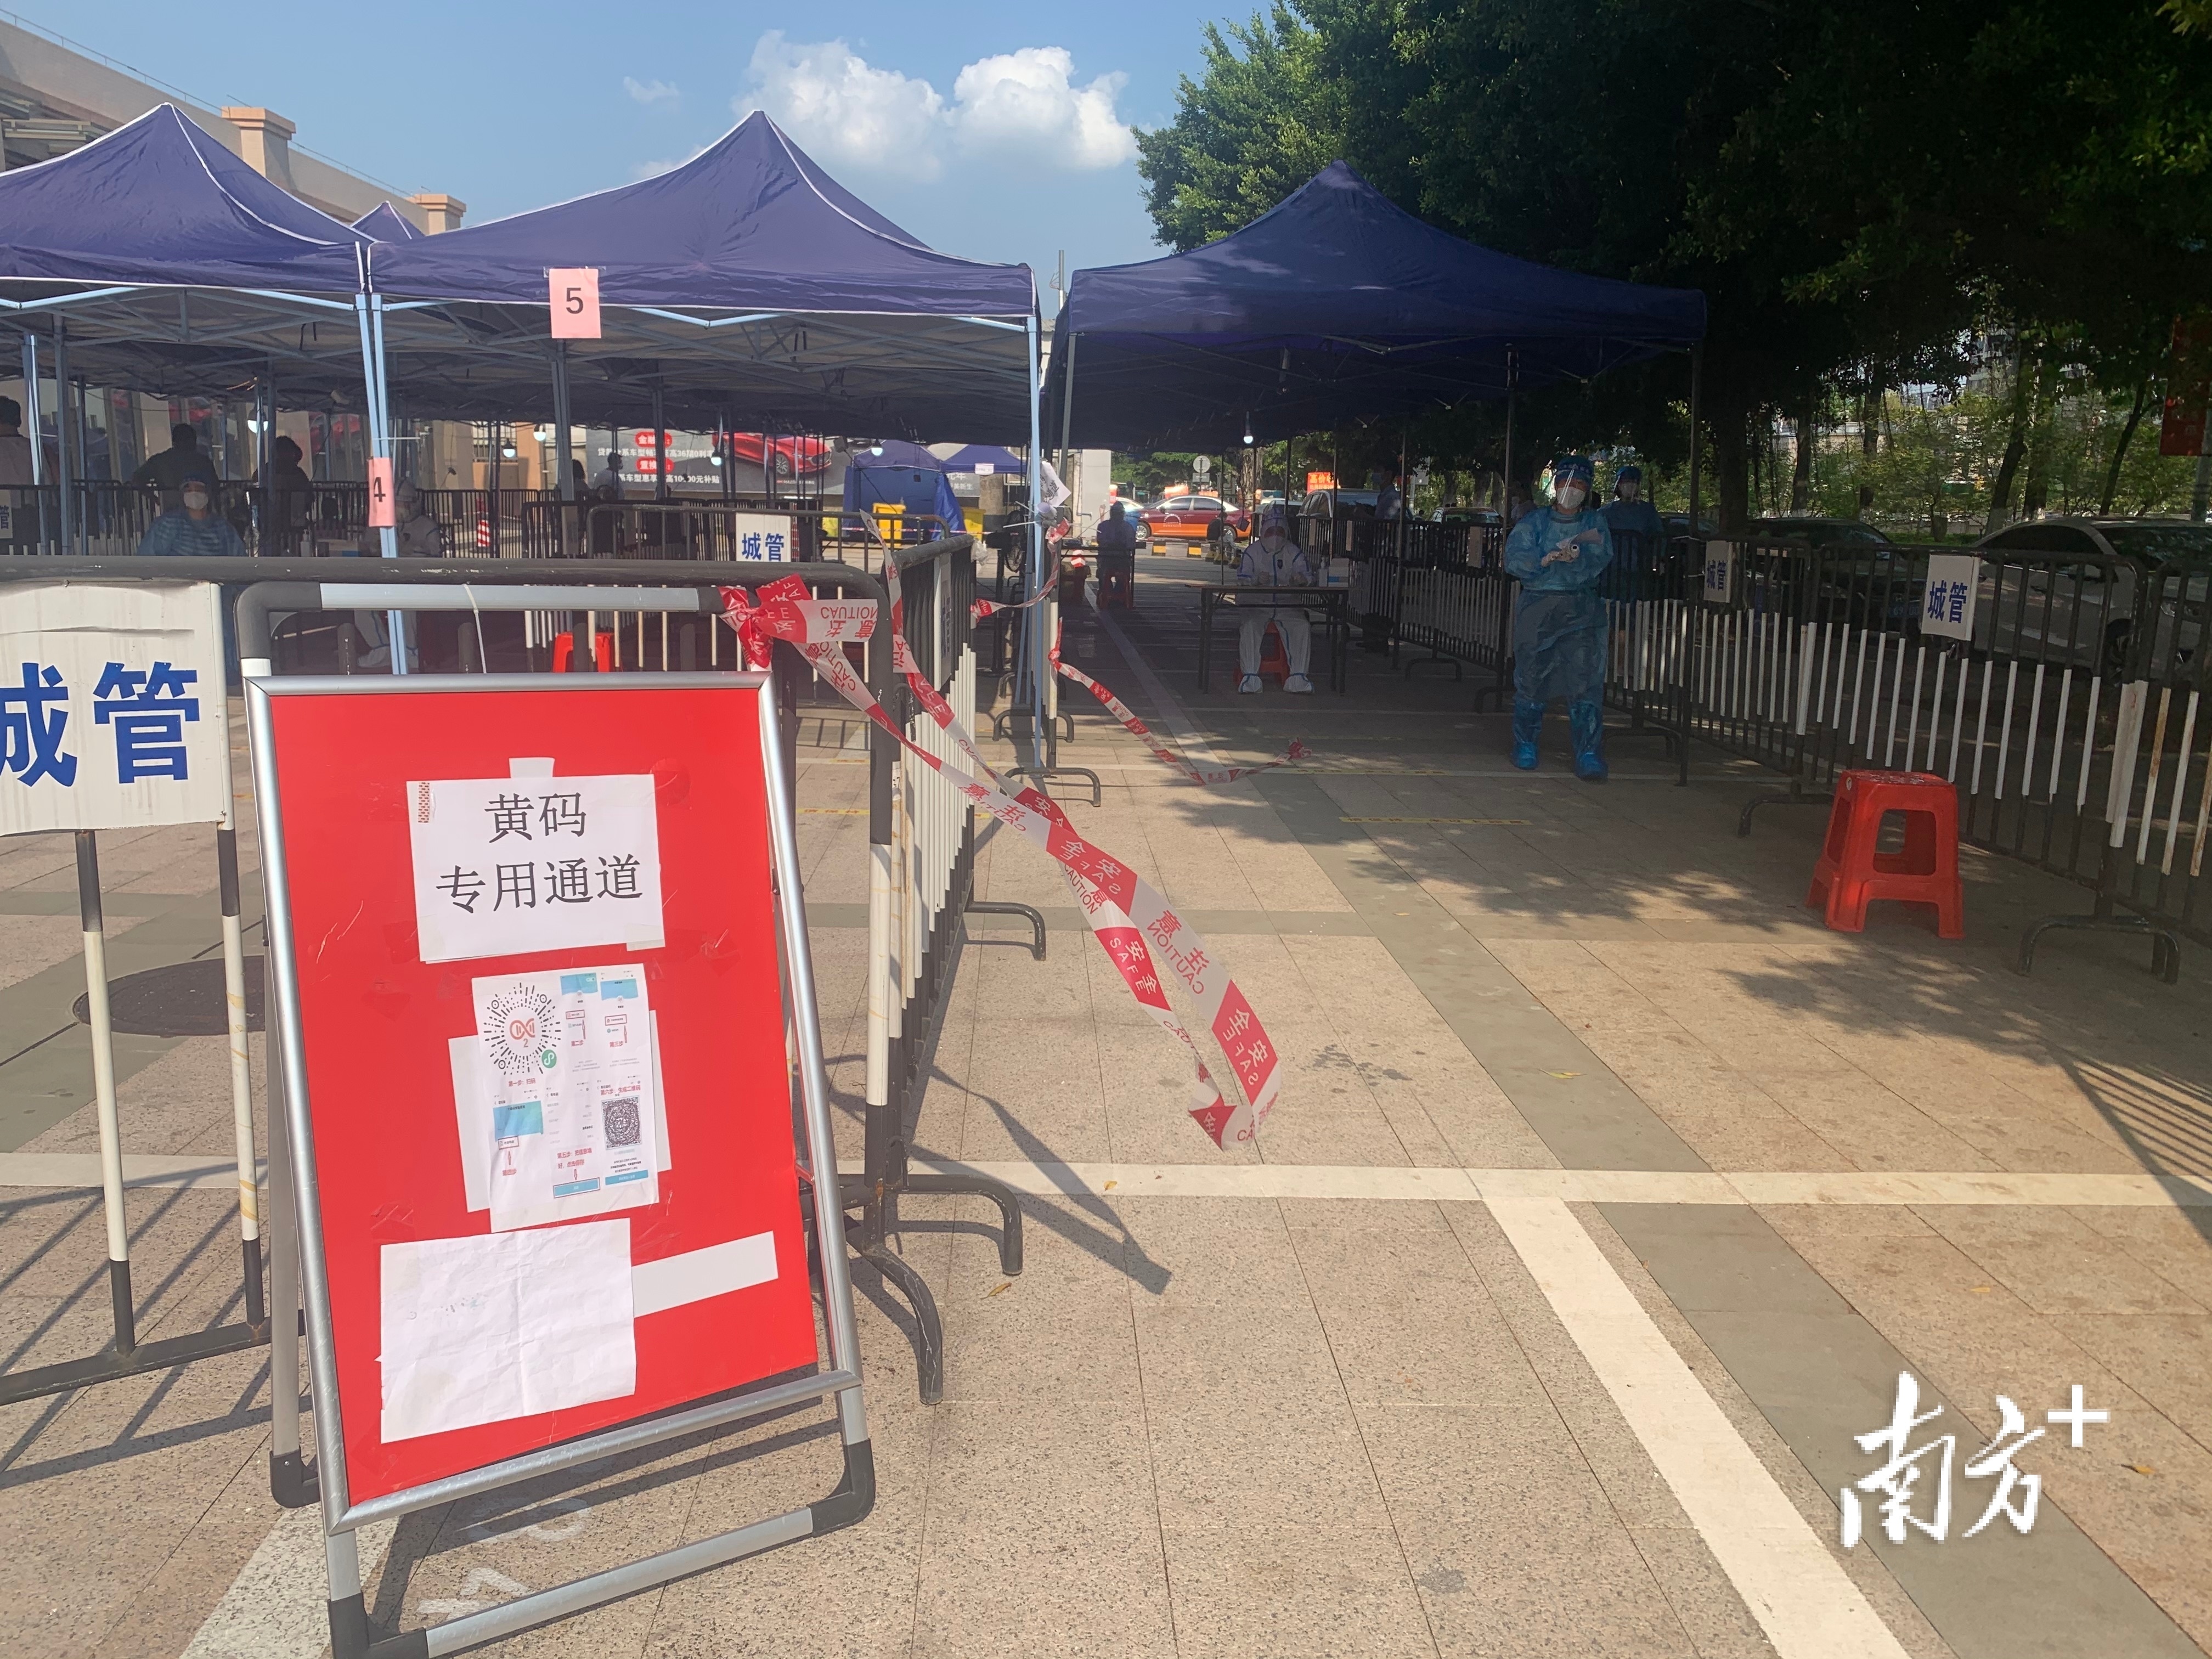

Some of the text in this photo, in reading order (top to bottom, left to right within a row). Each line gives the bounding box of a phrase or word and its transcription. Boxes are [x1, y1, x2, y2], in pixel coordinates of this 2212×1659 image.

[566, 287, 583, 314] 5
[374, 477, 386, 502] 4
[742, 532, 784, 562] 城管
[1707, 560, 1726, 591] 城管
[1927, 580, 1968, 623] 城管
[820, 641, 856, 691] CAUTIO
[484, 792, 586, 843] 黄码
[436, 854, 642, 913] 专用通道
[1064, 864, 1098, 915] CAUTION
[1110, 937, 1146, 991] SAFE
[1125, 940, 1158, 995] 安全
